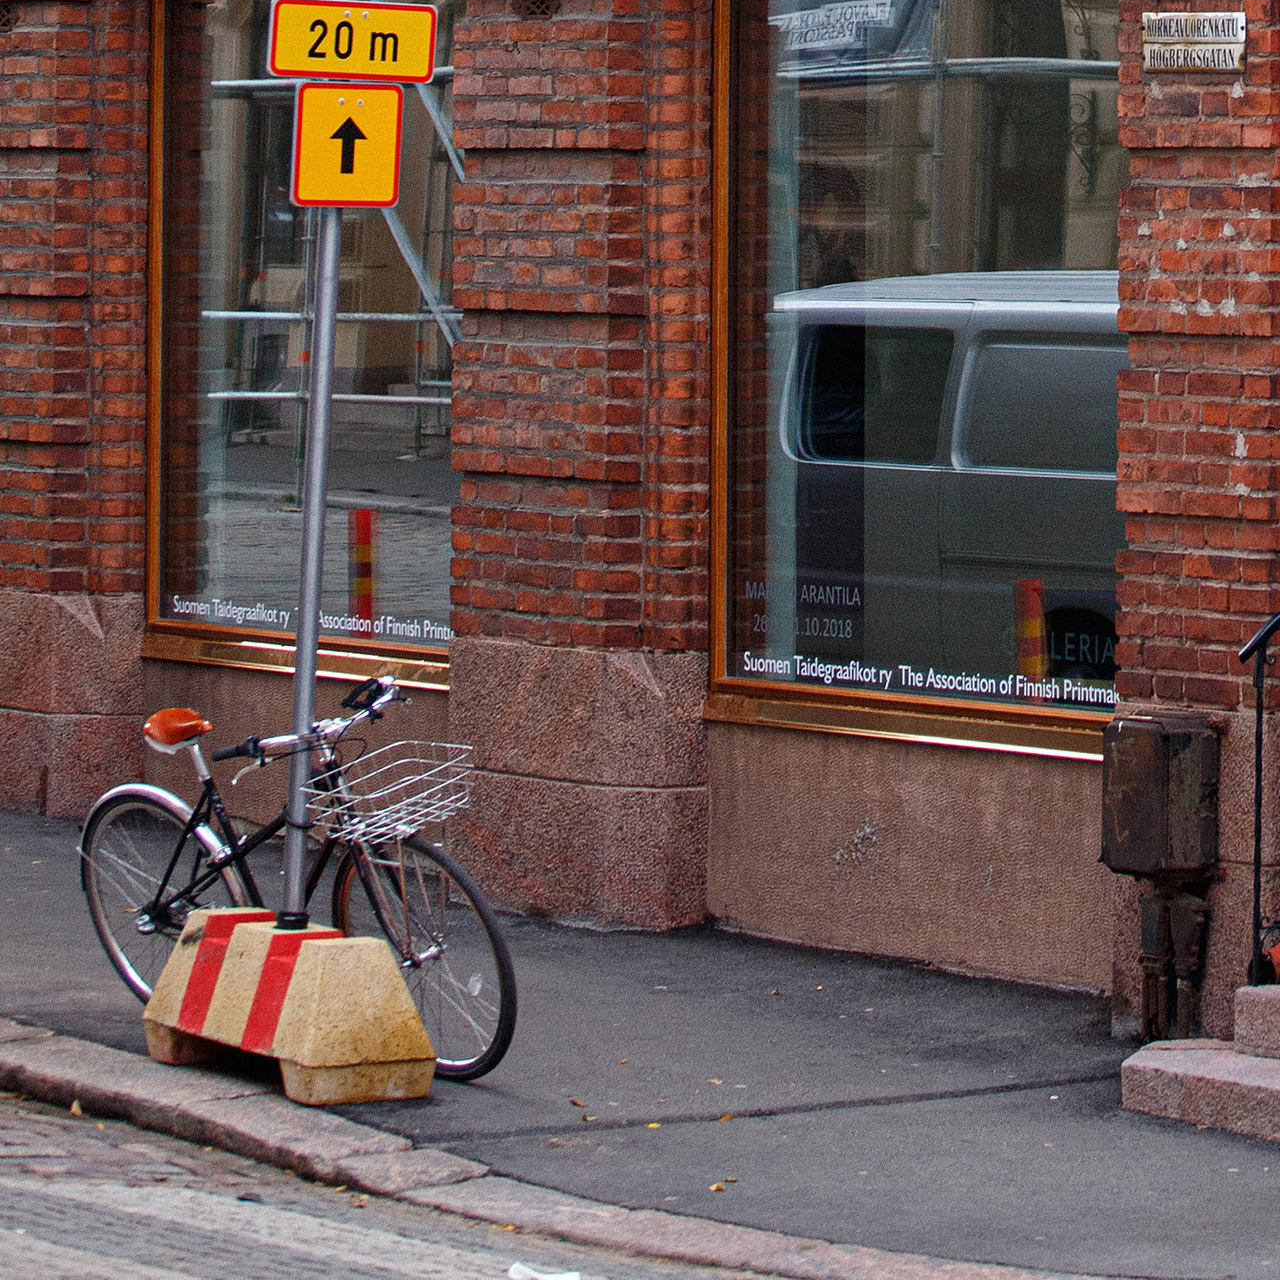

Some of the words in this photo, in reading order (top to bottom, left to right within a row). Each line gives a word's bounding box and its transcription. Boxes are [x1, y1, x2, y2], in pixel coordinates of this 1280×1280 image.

[308, 19, 353, 60] 20
[369, 32, 398, 62] m
[1147, 18, 1238, 38] KORKEAVUORENKATU
[1149, 47, 1235, 68] HÖGBERGSGATAN
[173, 594, 211, 615] Suomen
[212, 599, 277, 624] Taidegraafikot
[279, 611, 290, 629] ry
[373, 615, 385, 633] of
[386, 616, 421, 638] Finnish
[743, 651, 791, 675] Suomen
[793, 655, 876, 684] Taidegraafikot
[879, 668, 892, 690] ry
[899, 665, 923, 688] The
[926, 667, 996, 694] Association
[1000, 674, 1014, 695] of
[1015, 675, 1060, 700] Finnish
